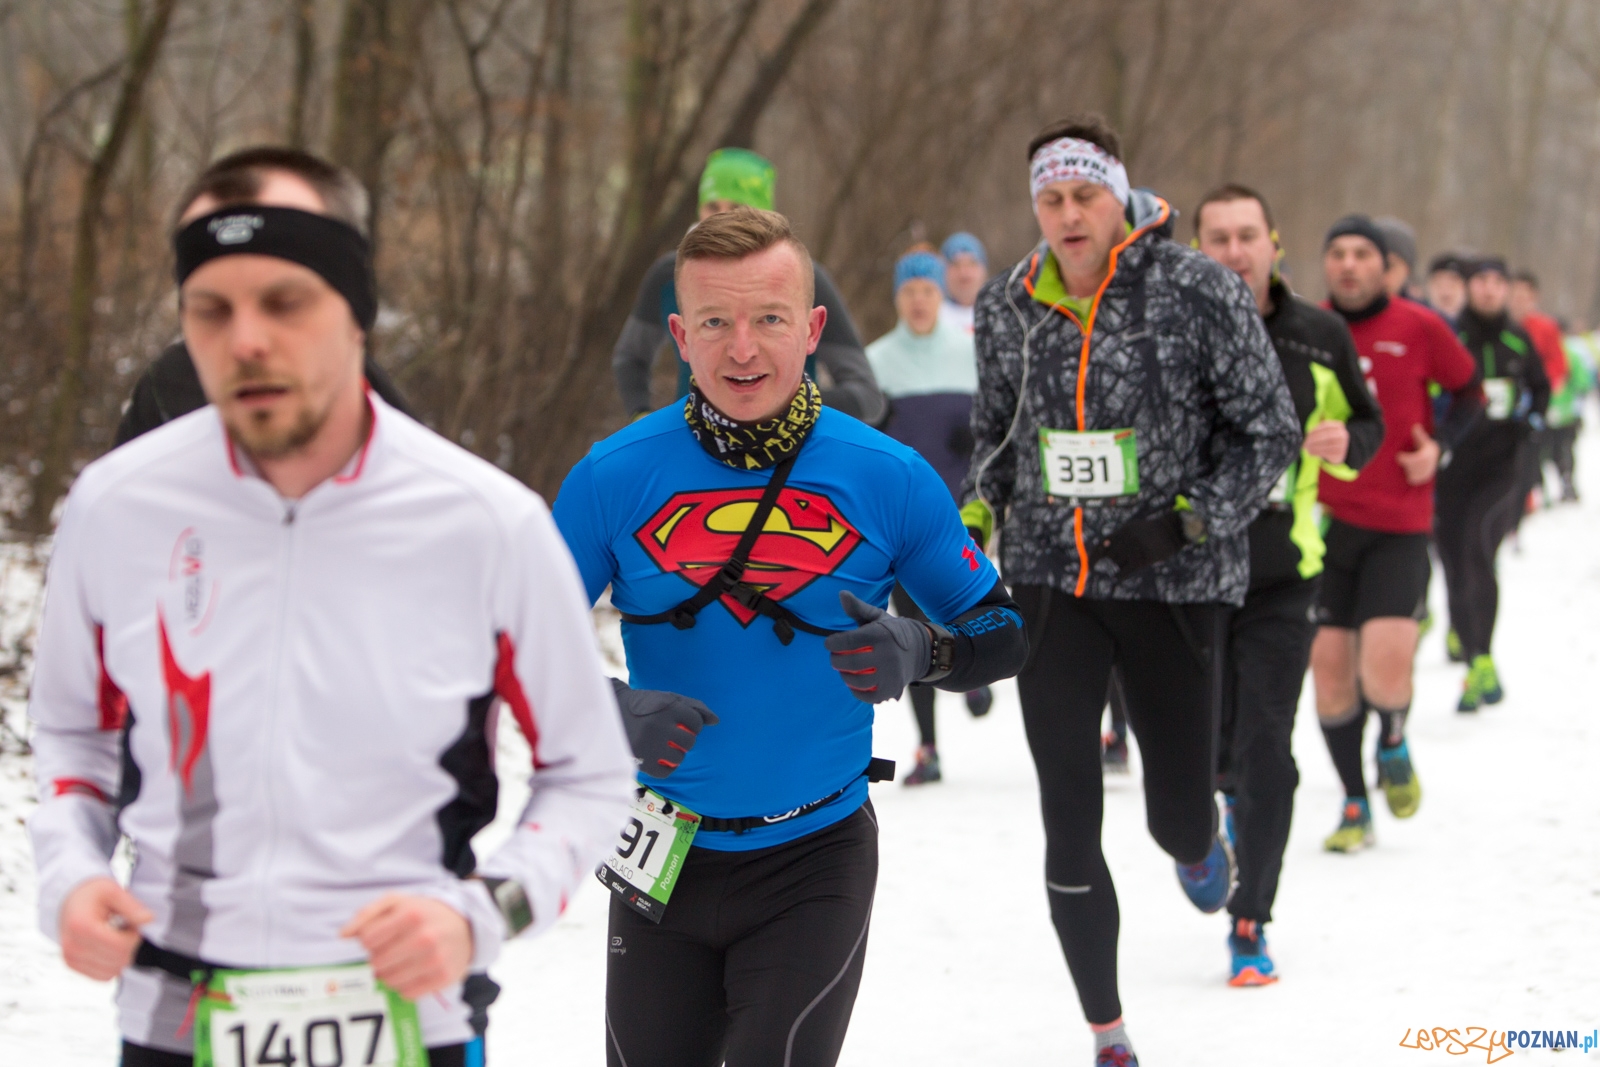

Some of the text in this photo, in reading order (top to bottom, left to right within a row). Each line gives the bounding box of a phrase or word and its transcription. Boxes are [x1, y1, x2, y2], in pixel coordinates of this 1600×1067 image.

[1058, 455, 1109, 483] 331
[660, 853, 680, 890] Poznań
[226, 1014, 385, 1067] 1407
